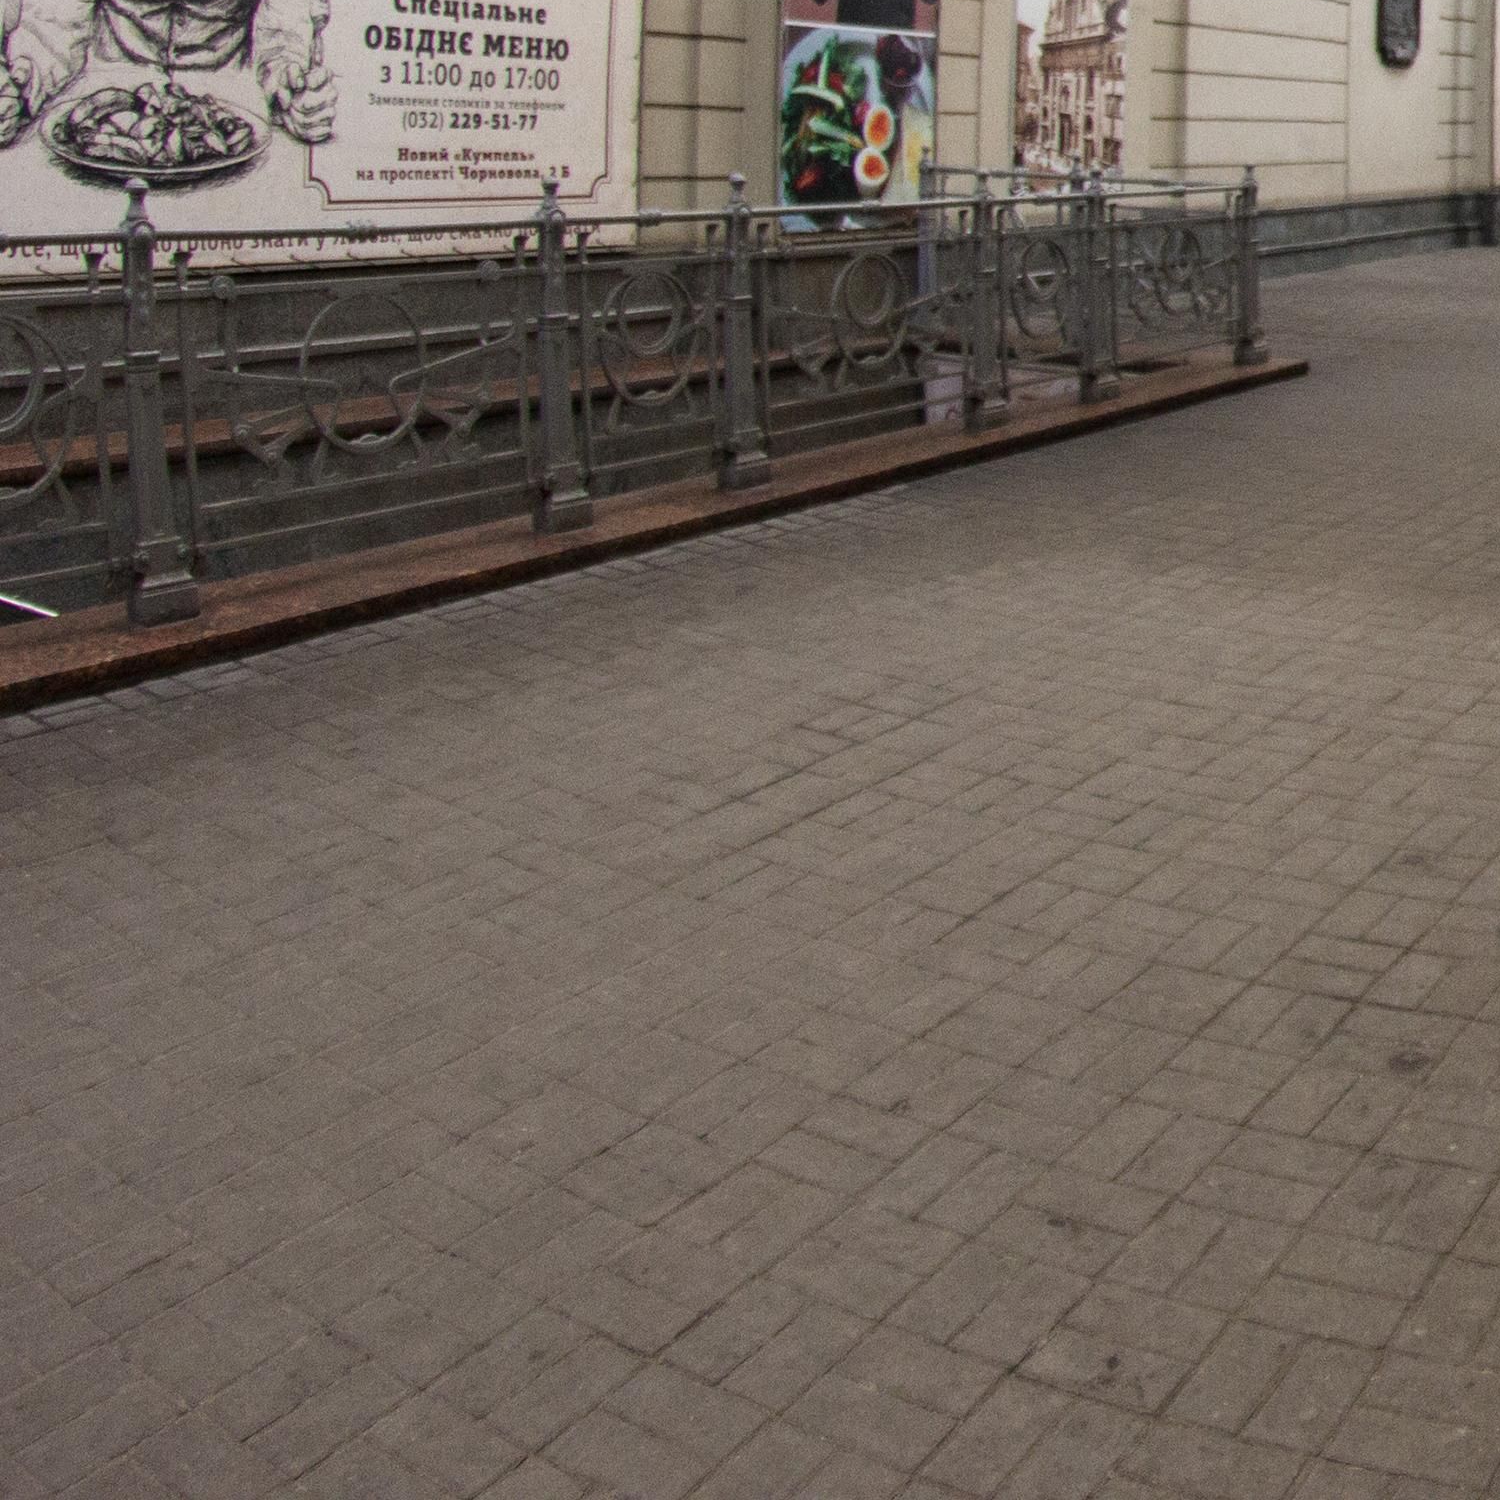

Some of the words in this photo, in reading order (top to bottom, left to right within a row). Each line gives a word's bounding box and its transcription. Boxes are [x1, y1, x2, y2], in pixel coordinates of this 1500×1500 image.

[365, 24, 474, 59] ОБІДНЄ
[482, 33, 570, 61] МЕНЮ
[380, 65, 391, 83] з
[401, 61, 462, 86] 11:00
[469, 70, 496, 92] до
[504, 67, 560, 91] 17:00
[367, 92, 438, 107] Замовлення
[402, 111, 444, 132] (032)
[449, 113, 538, 131] 229-51-77
[397, 148, 449, 162] Новий
[454, 148, 535, 165] «Кумпель»
[356, 169, 375, 181] на
[379, 166, 454, 184] проспекті
[560, 165, 570, 178] Б
